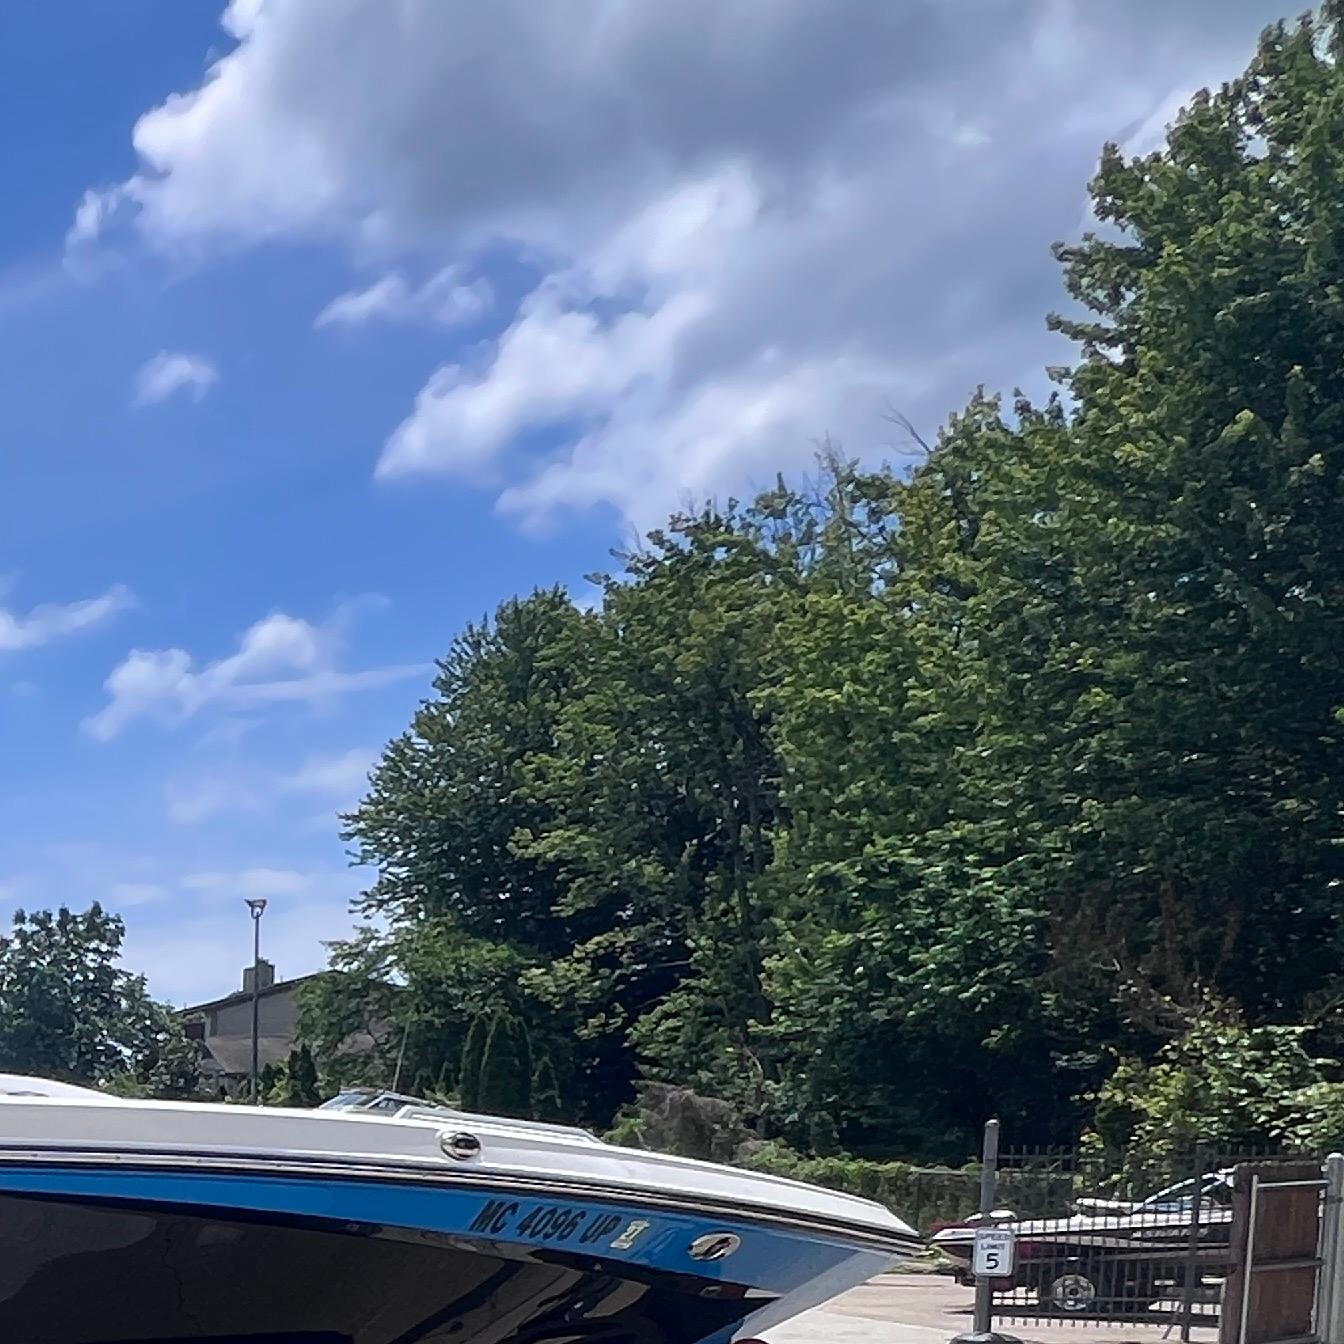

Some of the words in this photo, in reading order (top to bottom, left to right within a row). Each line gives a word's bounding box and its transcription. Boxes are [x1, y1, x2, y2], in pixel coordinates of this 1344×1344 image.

[470, 1200, 518, 1233] MC
[517, 1206, 586, 1241] 4096
[580, 1212, 622, 1244] UP
[985, 1253, 1000, 1270] 5
